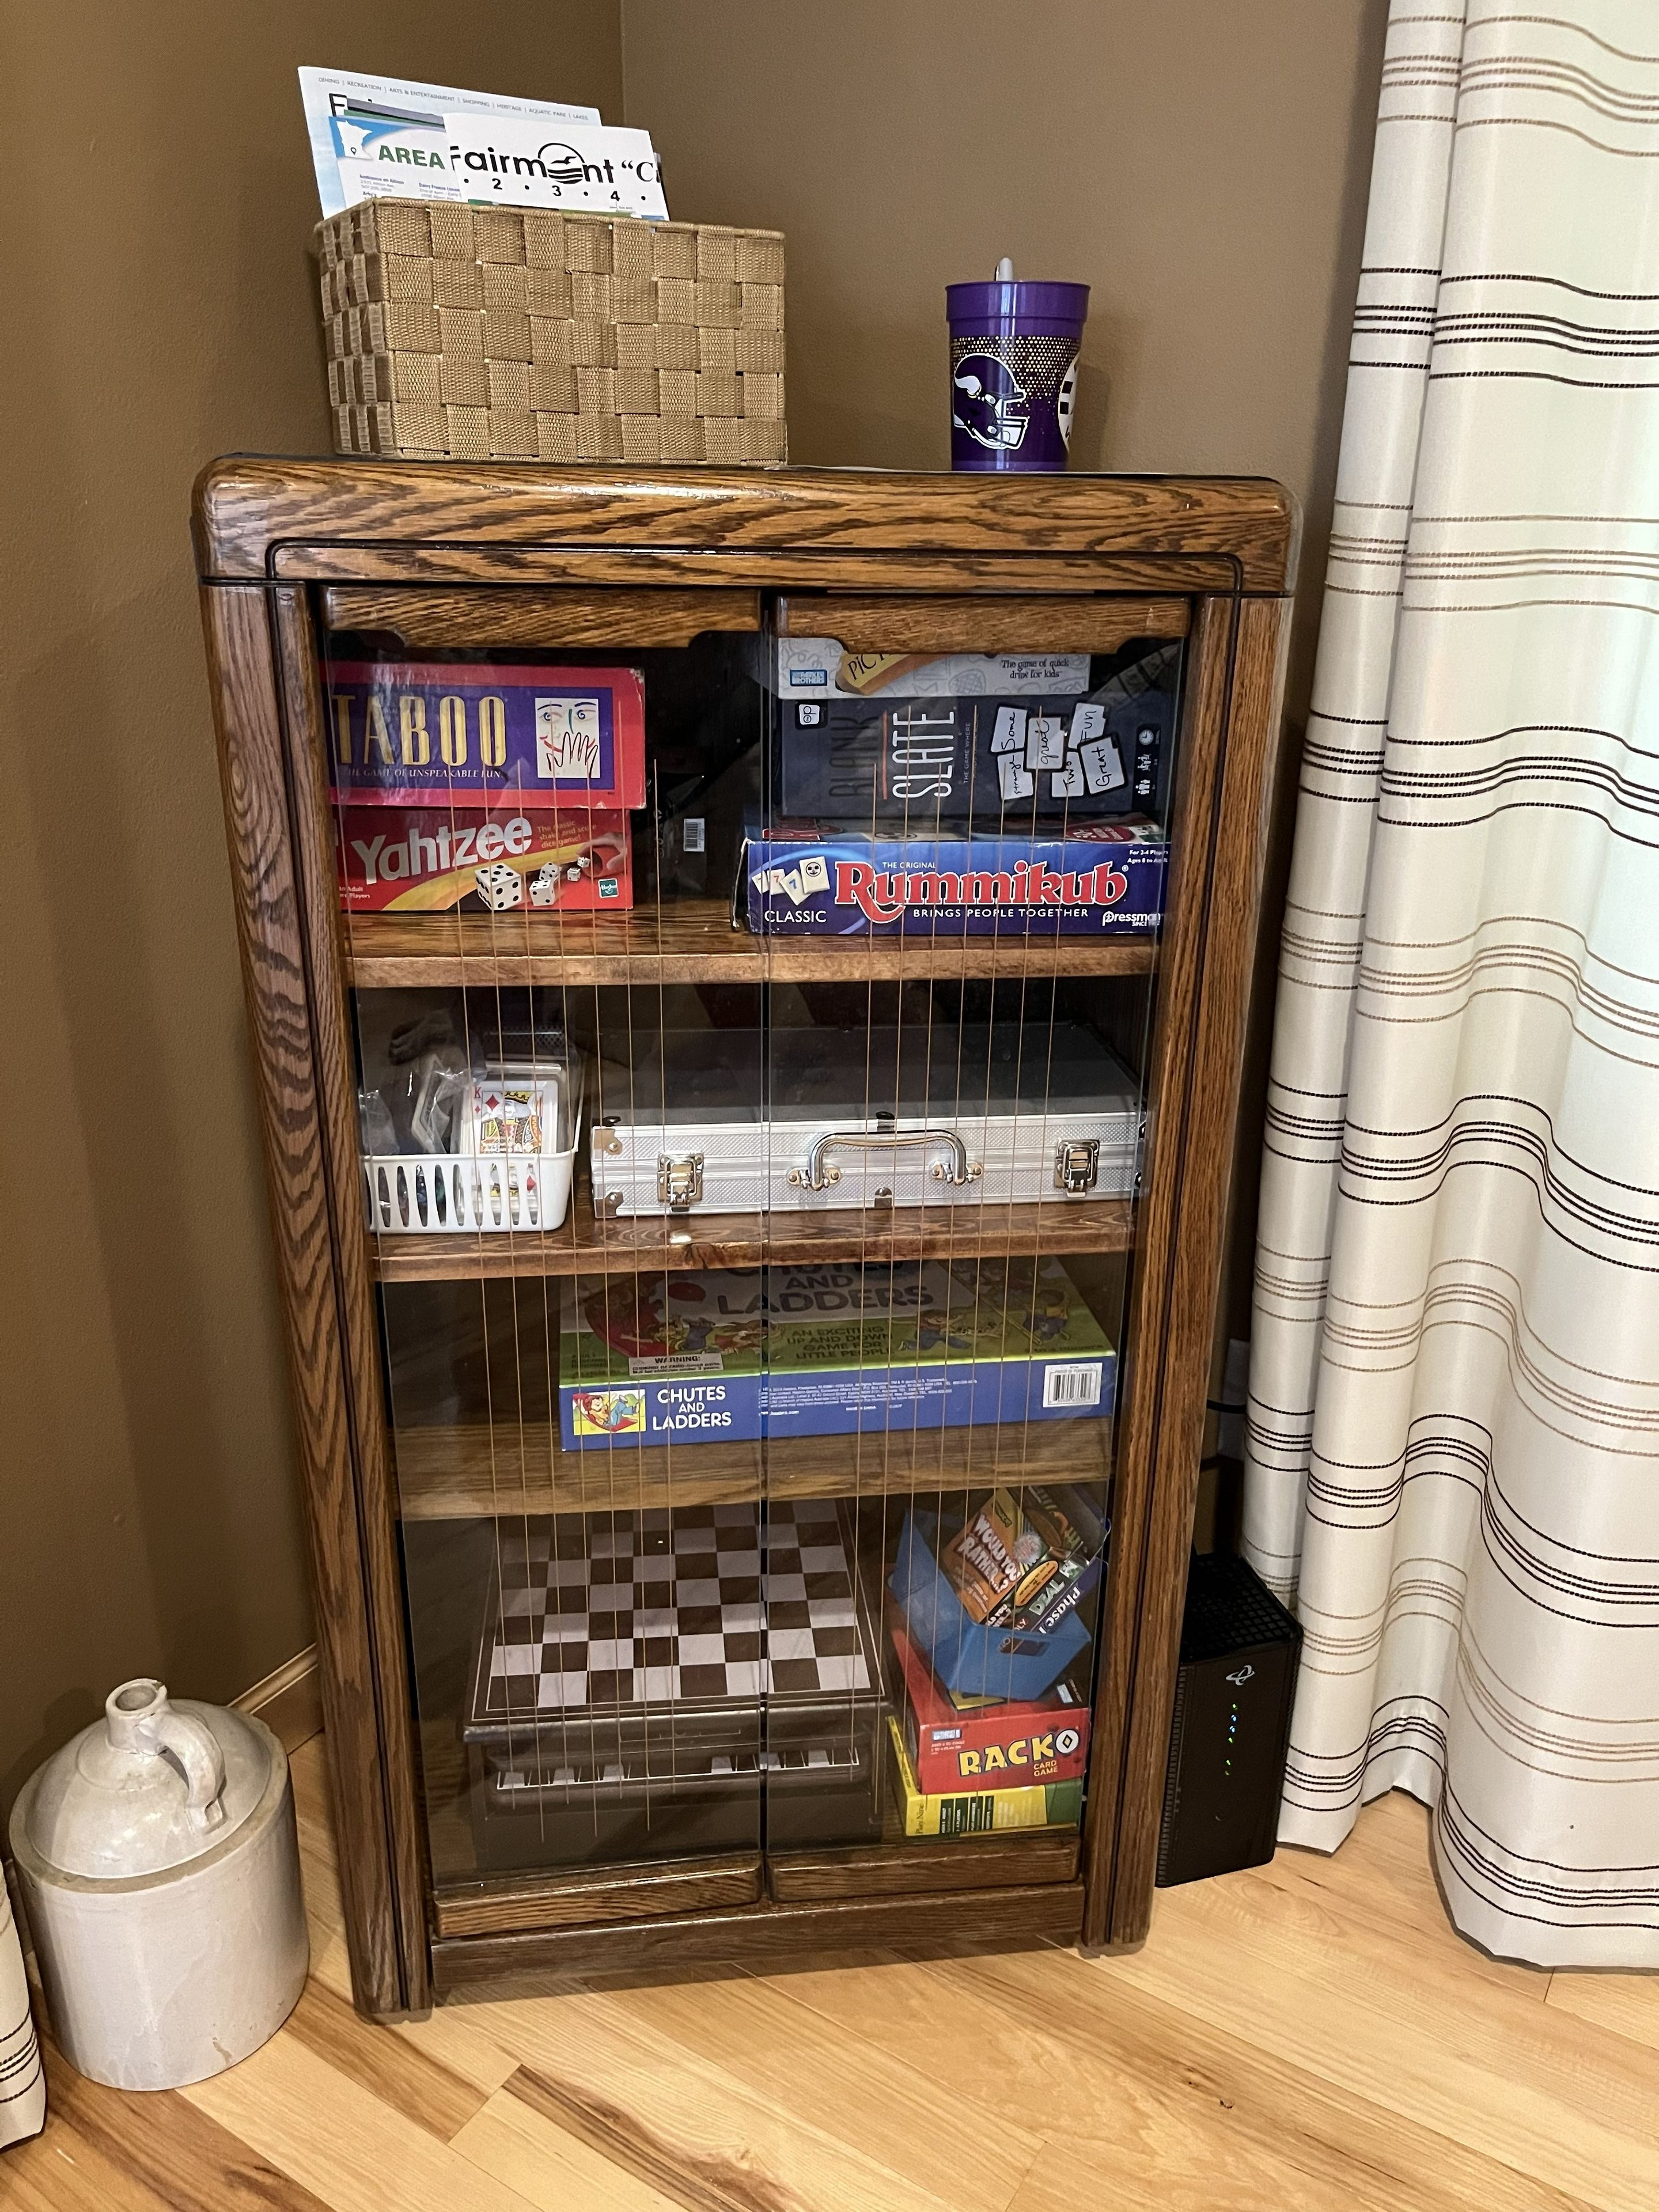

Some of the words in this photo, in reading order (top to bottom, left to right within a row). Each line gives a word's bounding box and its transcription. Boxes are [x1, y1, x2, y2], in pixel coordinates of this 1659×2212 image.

[378, 145, 446, 170] AREA
[491, 178, 503, 190] 2
[552, 185, 562, 196] 3
[611, 191, 620, 202] 4
[1018, 661, 1037, 672] game
[1039, 658, 1047, 668] of
[1031, 669, 1043, 678] for
[332, 695, 507, 767] TABOO
[1001, 711, 1016, 750] Some
[892, 711, 955, 798] SLATE
[350, 817, 532, 885] Yahtzee
[835, 859, 1128, 924] Rummikub
[764, 910, 827, 923] CLASSIC
[913, 909, 961, 918] BRINGS
[967, 908, 1014, 918] PEOPLE
[1018, 908, 1088, 917] TOGETHER
[474, 1086, 481, 1099] K
[786, 1274, 854, 1290] AND
[717, 1285, 934, 1315] LADDERS
[809, 1335, 841, 1344] AND
[796, 1351, 835, 1359] LITTLE
[657, 1385, 726, 1404] CHUTES
[679, 1402, 706, 1413] AND
[652, 1411, 732, 1431] LADDERS
[974, 1513, 1006, 1561] WOULD
[1029, 1579, 1065, 1616] DEAL
[1046, 1586, 1081, 1627] Phase
[1033, 1759, 1057, 1770] CARD
[1033, 1766, 1058, 1777] GAME
